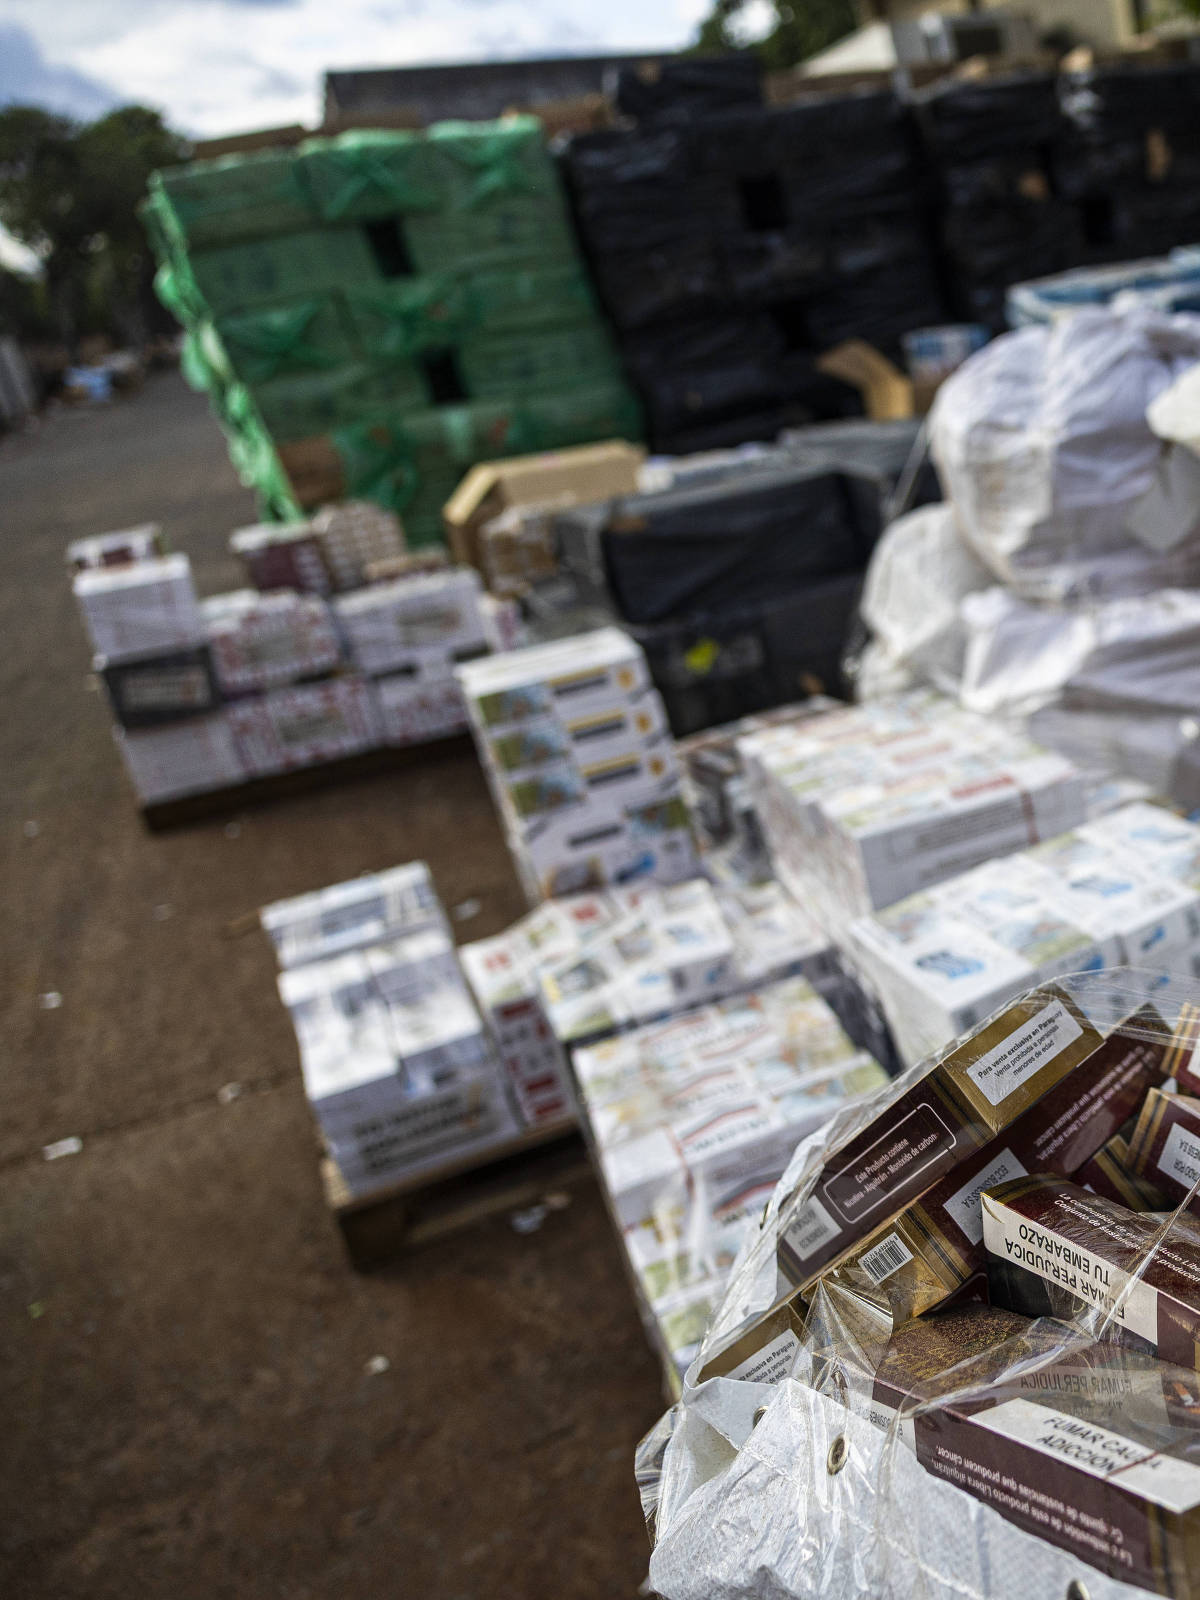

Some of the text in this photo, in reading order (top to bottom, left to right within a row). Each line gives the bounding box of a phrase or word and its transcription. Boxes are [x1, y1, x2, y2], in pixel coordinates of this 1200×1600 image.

[976, 1064, 994, 1079] Para
[990, 1052, 1009, 1069] venta
[1007, 1034, 1032, 1055] exclusiva
[1037, 1010, 1062, 1030] Paraguay
[1012, 1056, 1035, 1076] menores
[1040, 1039, 1055, 1053] edad
[854, 1137, 910, 1184] Este Producto contiene
[909, 1146, 920, 1157] de
[916, 1131, 940, 1152] carbon
[1005, 1238, 1076, 1288] PERJUDICA
[1019, 1224, 1110, 1287] TU EMBARAZO
[1158, 1259, 1200, 1282] producen
[1044, 1417, 1104, 1443] FUMAR
